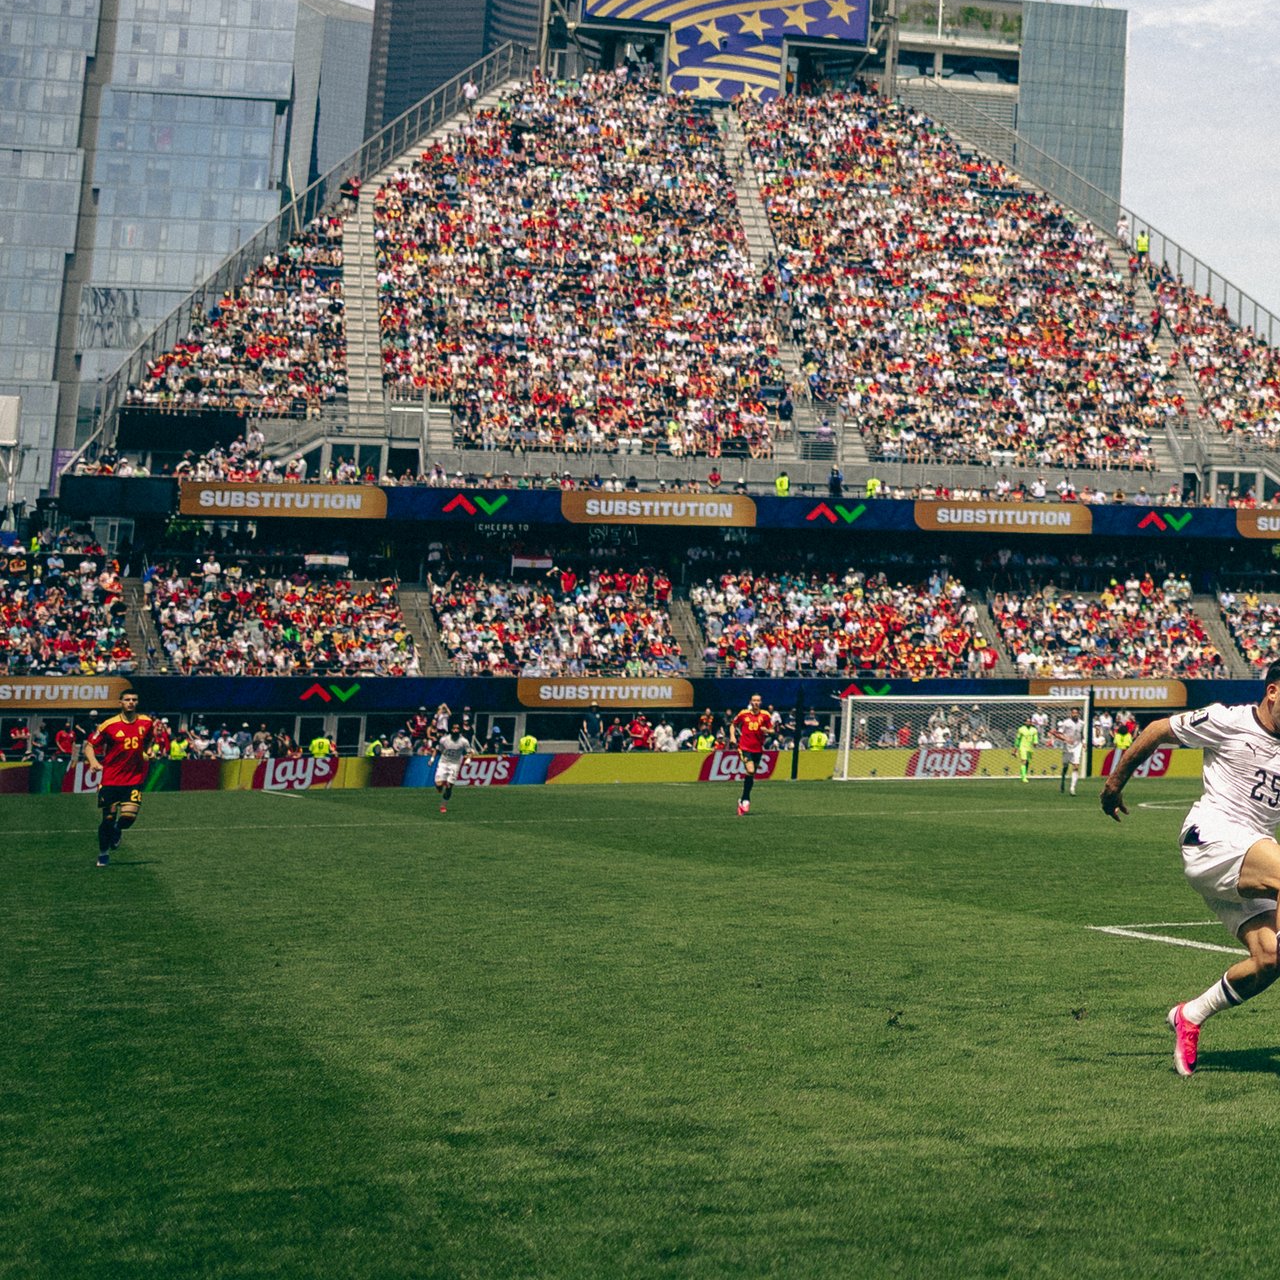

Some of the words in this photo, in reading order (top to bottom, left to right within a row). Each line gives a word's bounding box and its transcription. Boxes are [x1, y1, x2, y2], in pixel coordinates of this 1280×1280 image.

[199, 490, 362, 510] SUBSTITUTION
[585, 499, 733, 518] SUBSTITUTION
[936, 508, 1071, 526] SUBSTITUTION
[539, 685, 673, 700] SUBSTITUTION
[124, 736, 139, 750] 26
